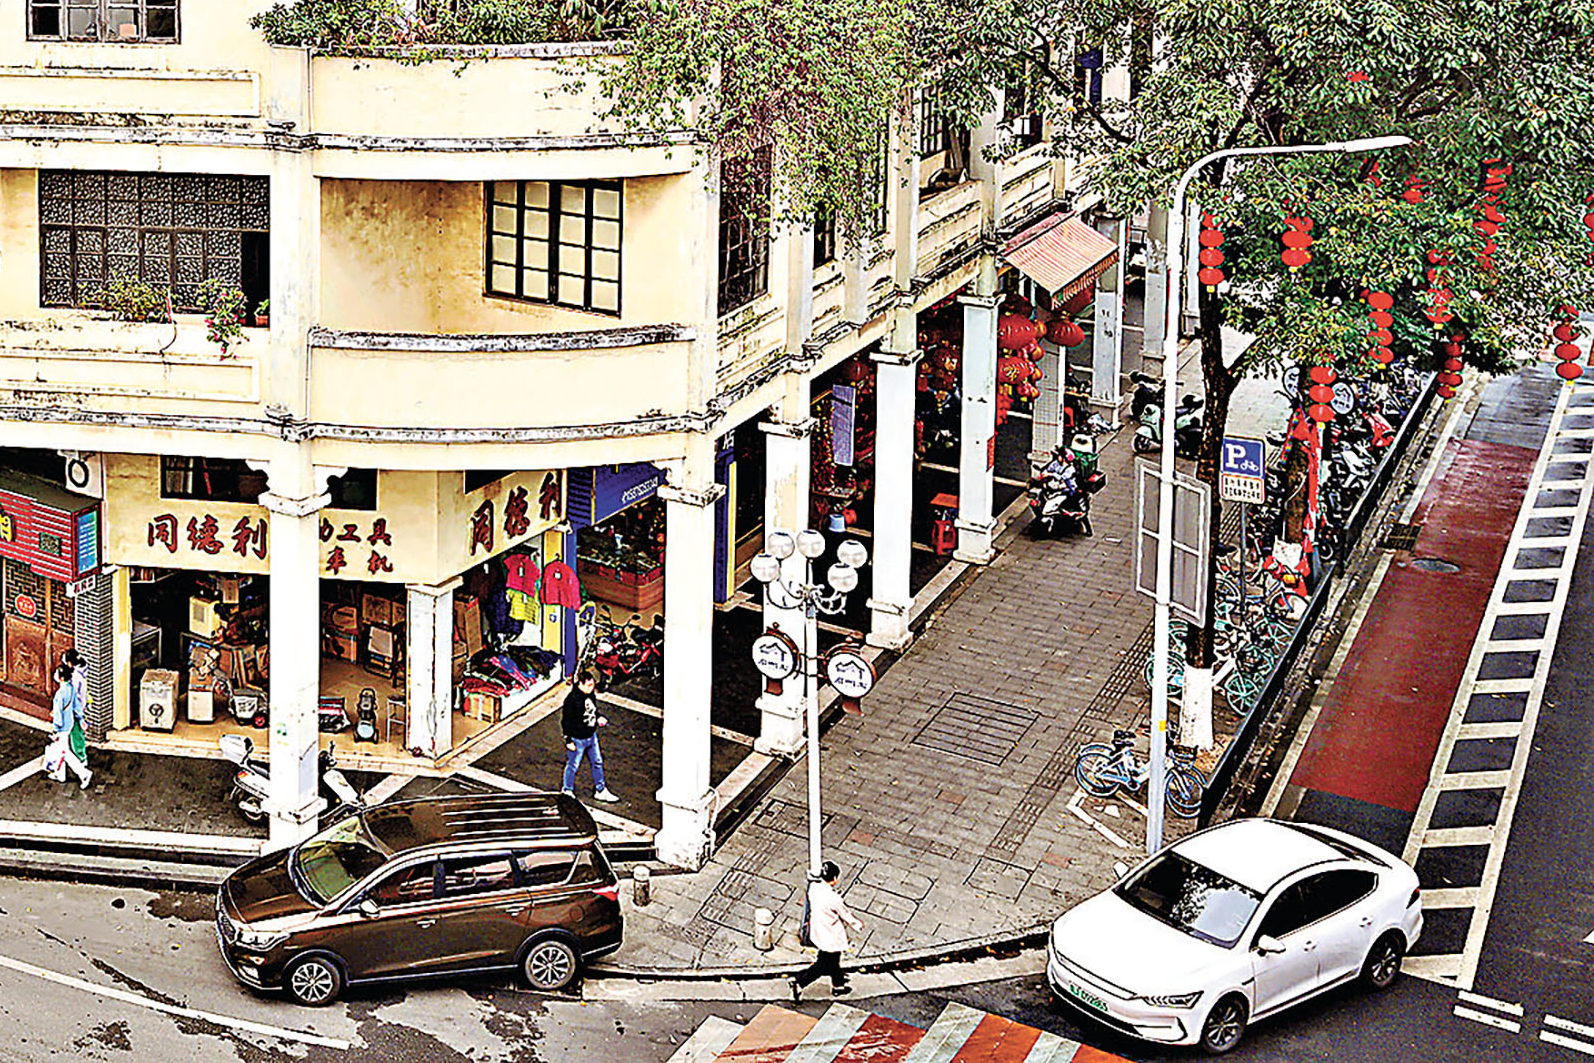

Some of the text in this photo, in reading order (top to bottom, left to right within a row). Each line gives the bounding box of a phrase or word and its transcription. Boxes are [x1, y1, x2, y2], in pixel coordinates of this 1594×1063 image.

[1225, 443, 1246, 469] P
[147, 513, 268, 560] 同德利
